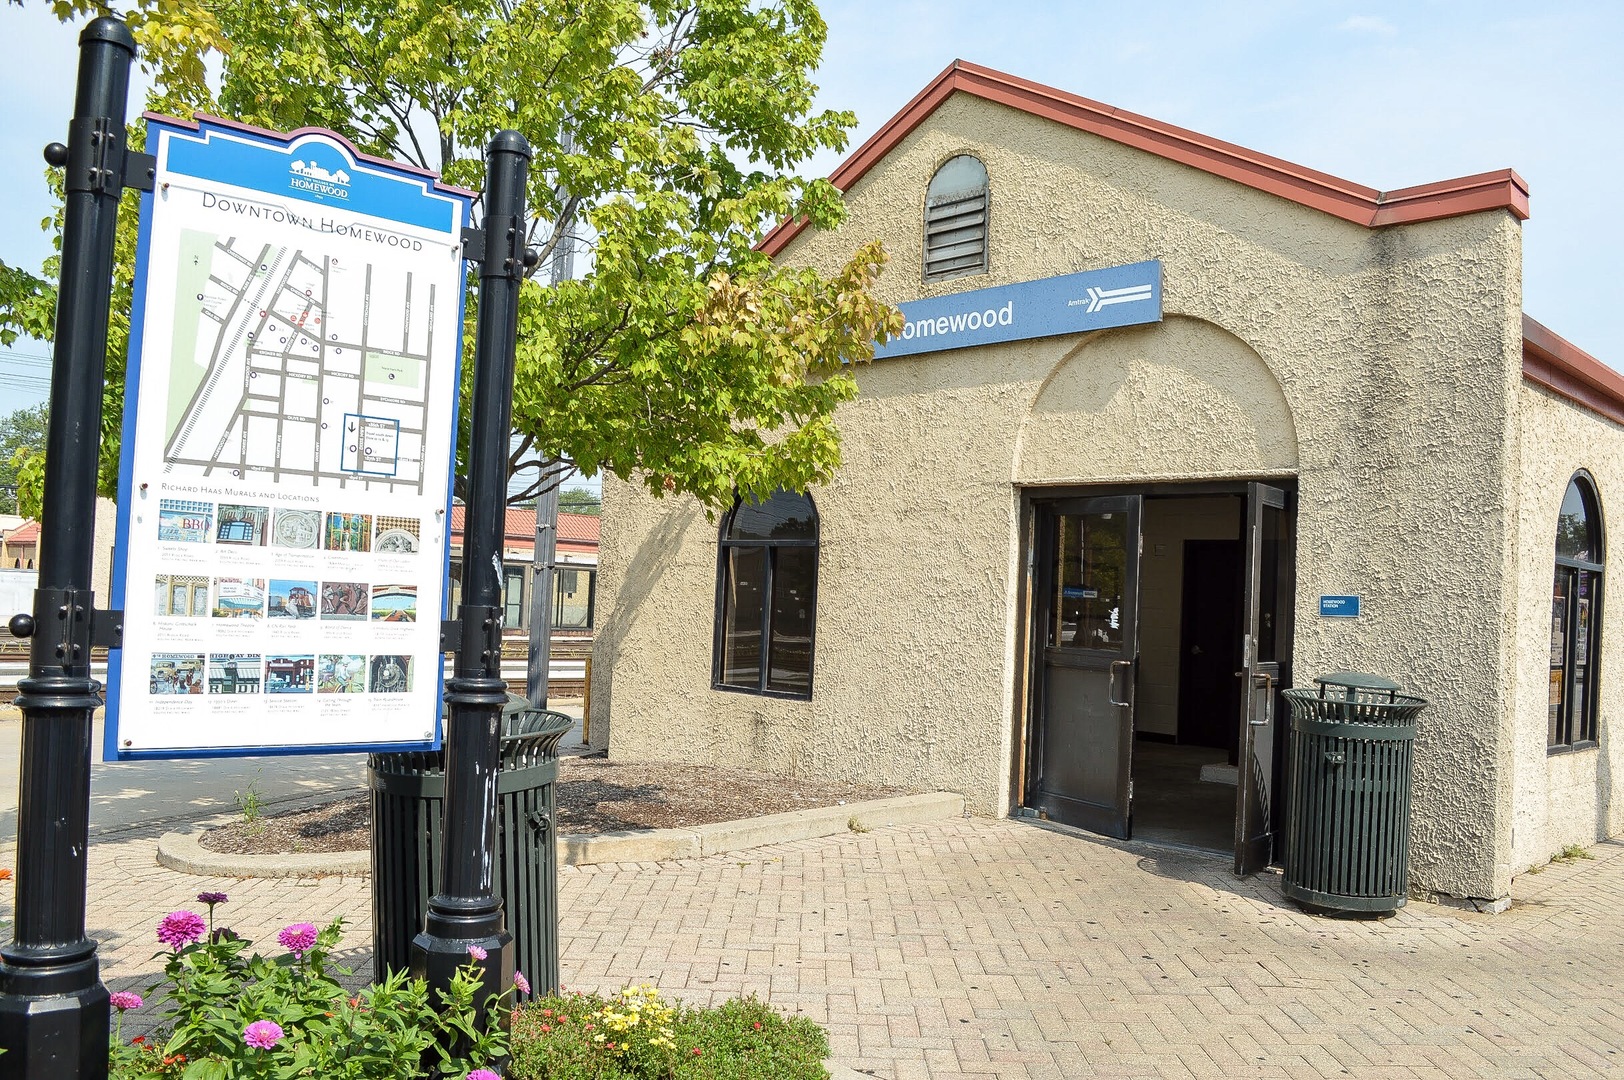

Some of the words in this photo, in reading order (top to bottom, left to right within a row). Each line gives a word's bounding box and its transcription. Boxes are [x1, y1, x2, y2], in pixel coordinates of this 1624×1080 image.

[291, 178, 348, 198] HOMEWOOD
[203, 192, 313, 230] DOWNTOWN
[321, 217, 422, 252] HOMEWOOD
[886, 300, 1013, 342] omewood
[162, 483, 198, 493] RICHARD
[201, 486, 222, 495] HAAS
[225, 488, 257, 498] MURALS
[278, 493, 319, 502] LOCATIONS
[183, 518, 210, 531] BBQ
